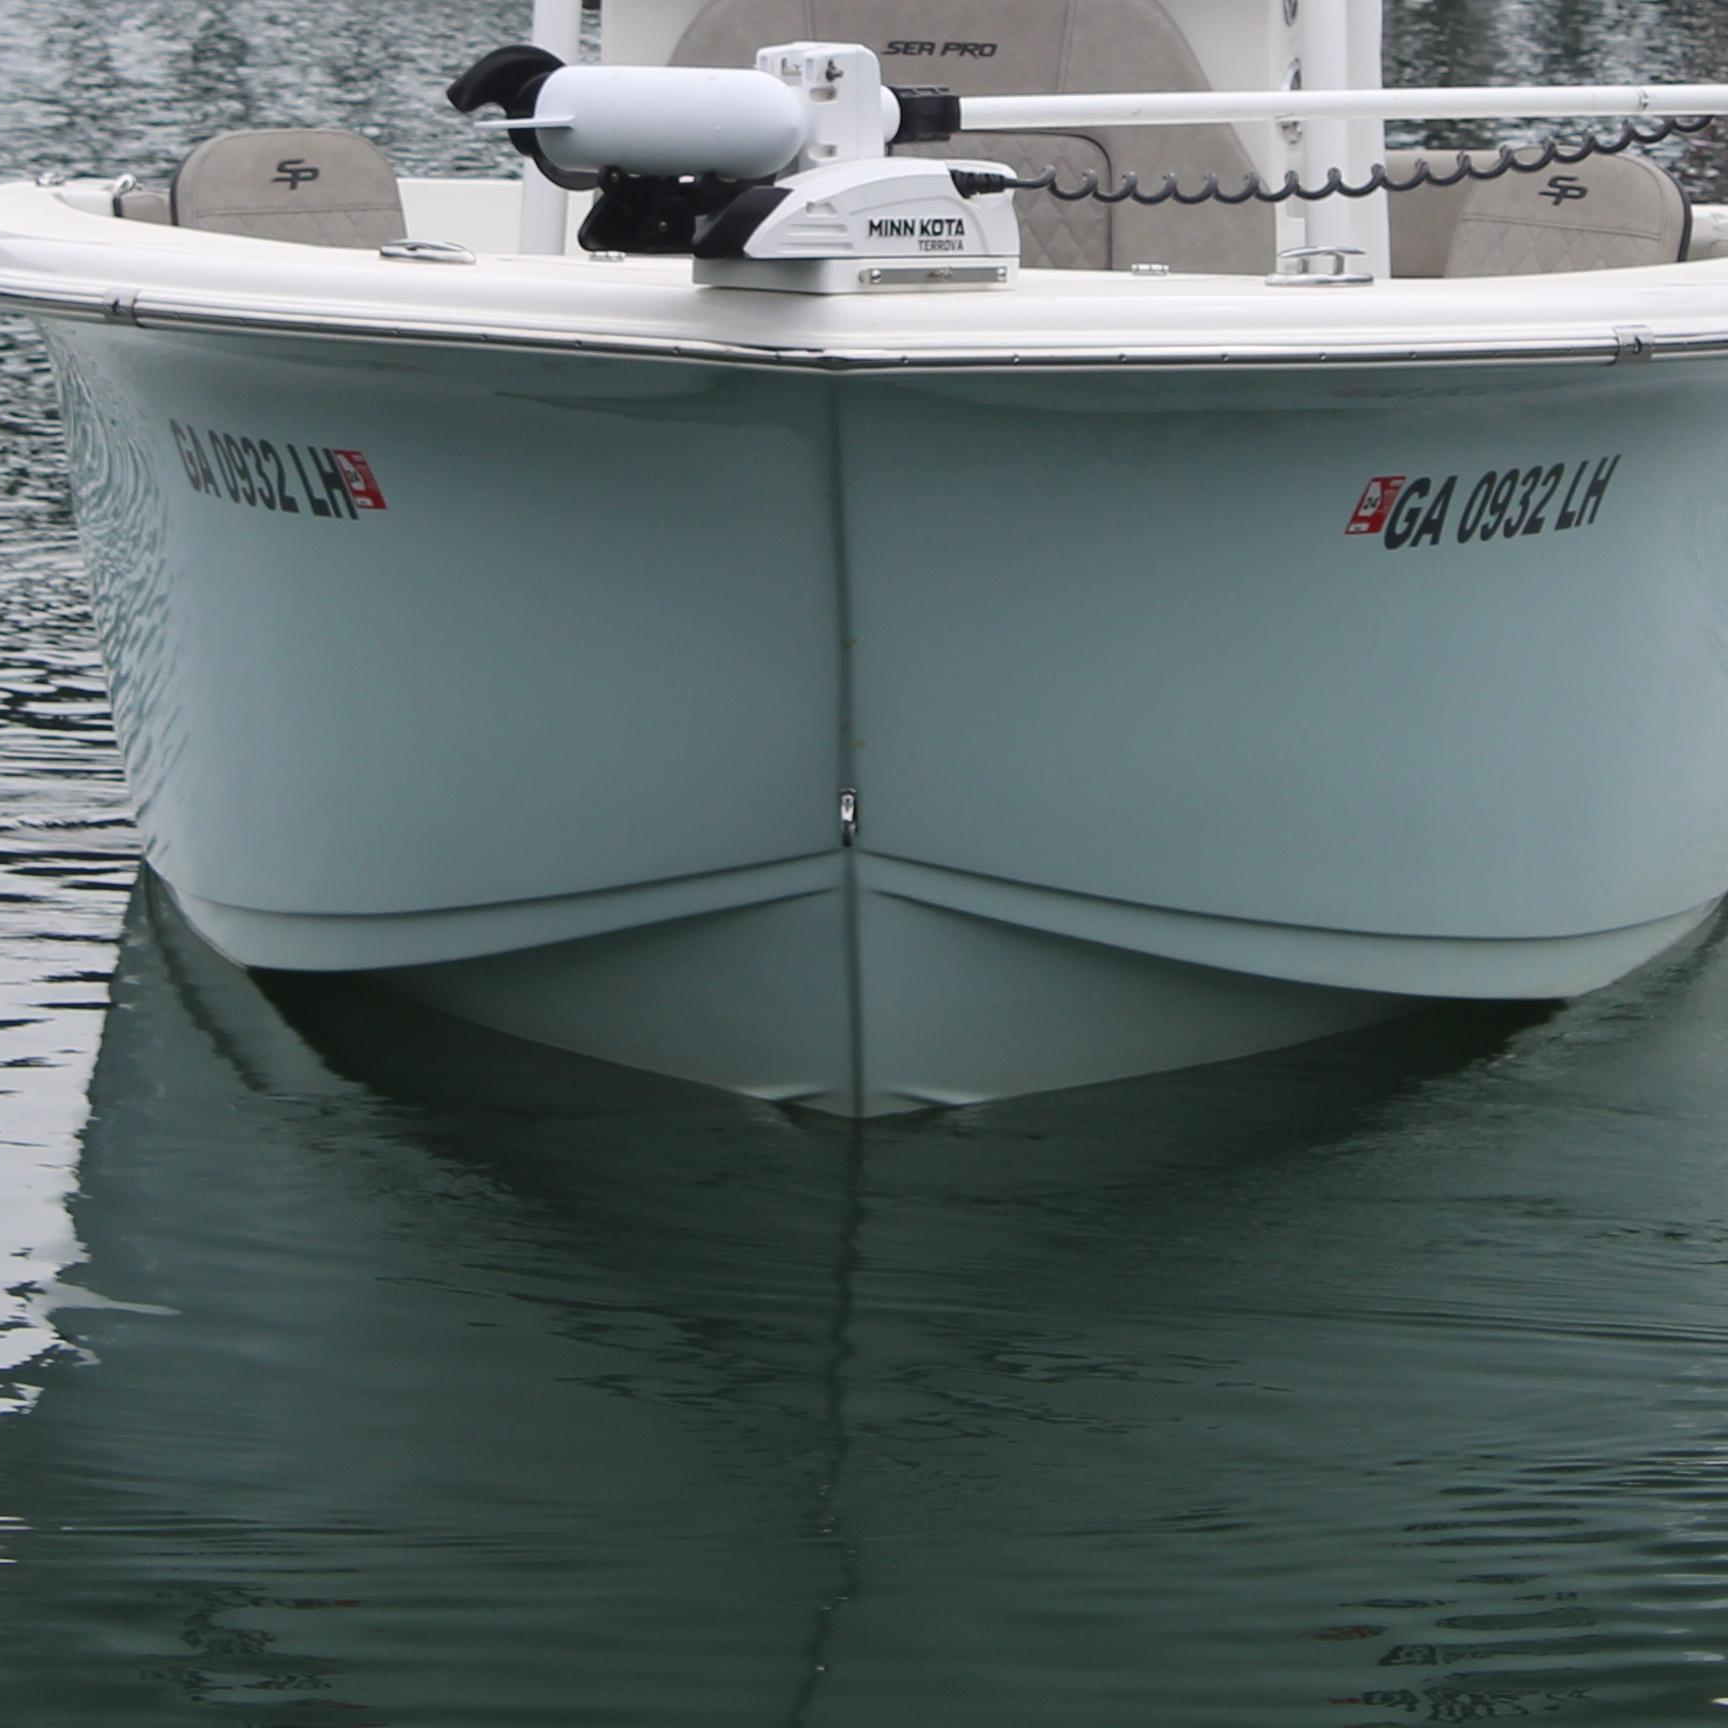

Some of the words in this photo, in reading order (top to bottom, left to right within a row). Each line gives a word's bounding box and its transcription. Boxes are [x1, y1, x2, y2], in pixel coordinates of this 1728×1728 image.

[882, 40, 936, 56] SEA
[940, 41, 998, 58] PRO
[867, 218, 916, 237] MINN
[919, 218, 966, 236] KOTA
[917, 239, 964, 252] TERROVA
[169, 417, 222, 498] GA
[207, 428, 301, 514] 0932
[286, 442, 360, 520] LH
[1383, 475, 1458, 550] GA
[1457, 462, 1565, 544] 0932
[1554, 454, 1622, 532] LH
